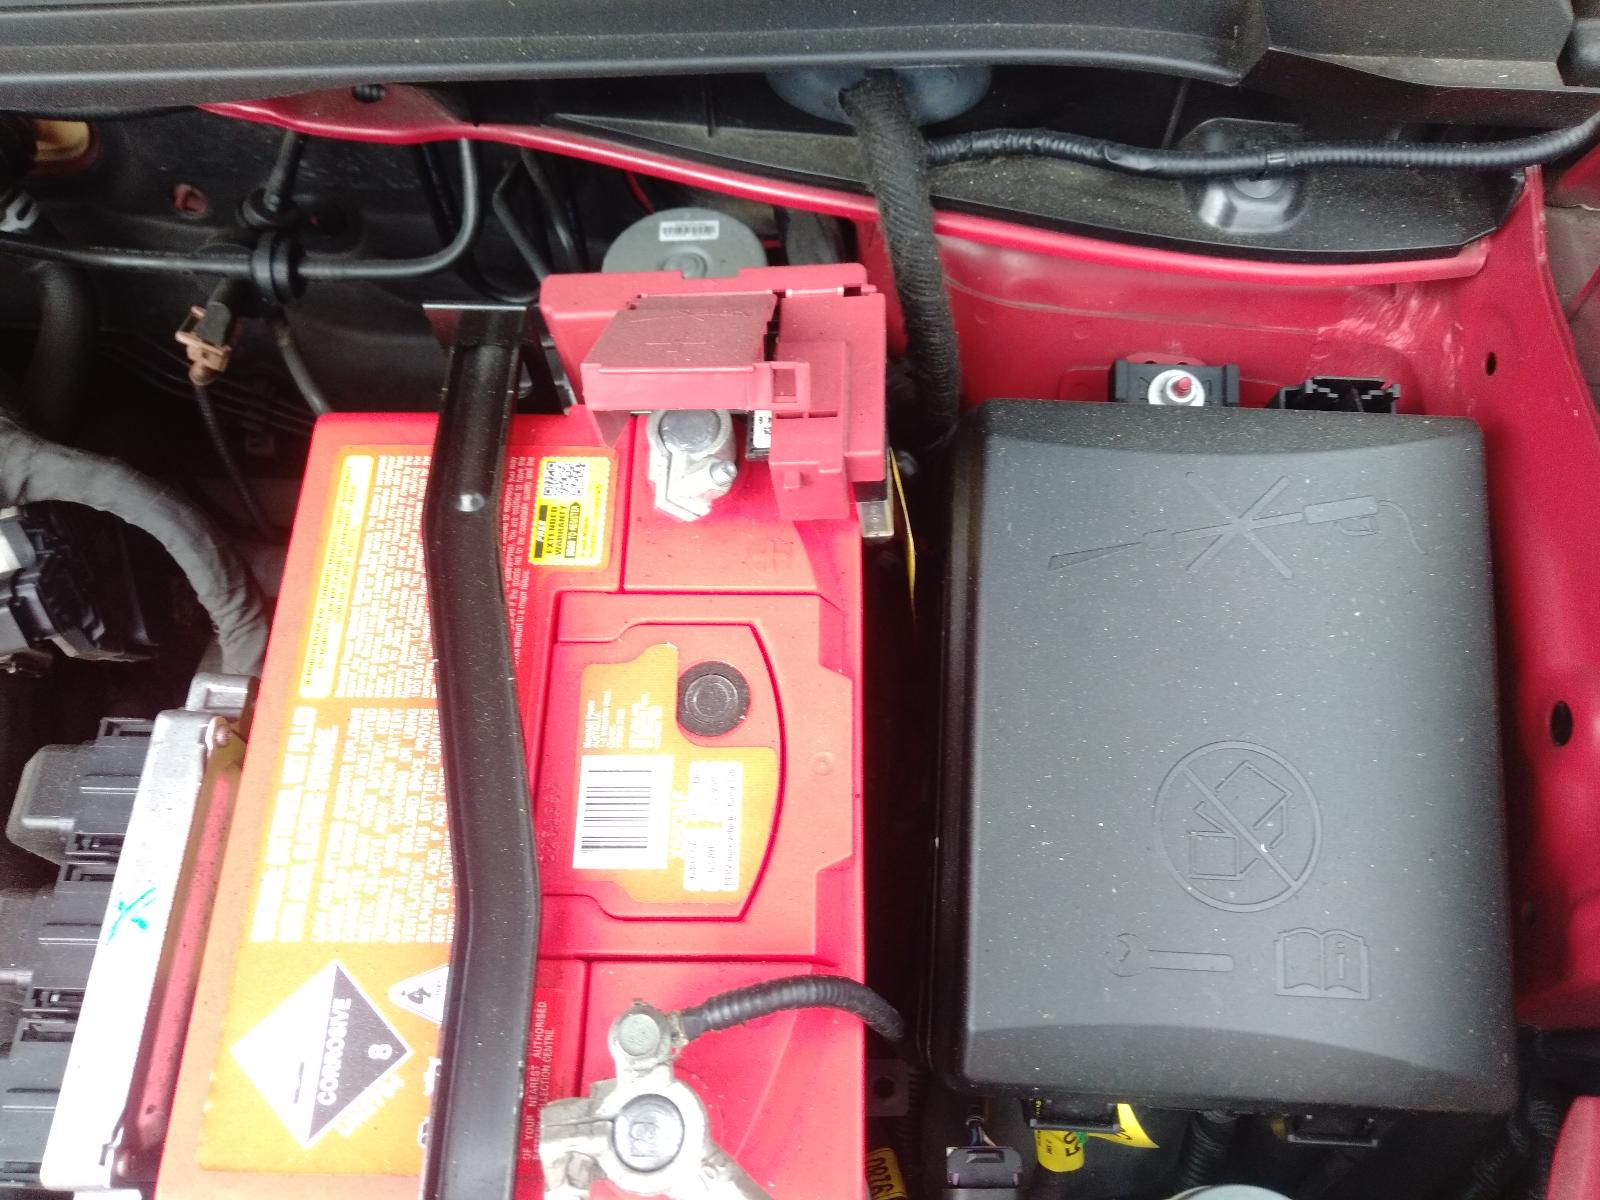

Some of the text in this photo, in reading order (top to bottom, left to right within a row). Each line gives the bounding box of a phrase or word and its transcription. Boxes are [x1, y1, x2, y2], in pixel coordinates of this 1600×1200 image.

[533, 1001, 547, 1058] AUTHORISED
[317, 998, 352, 1106] CORROSIVE
[367, 1044, 393, 1060] 8
[527, 1065, 540, 1107] NEAREST
[524, 1115, 535, 1141] YOUR
